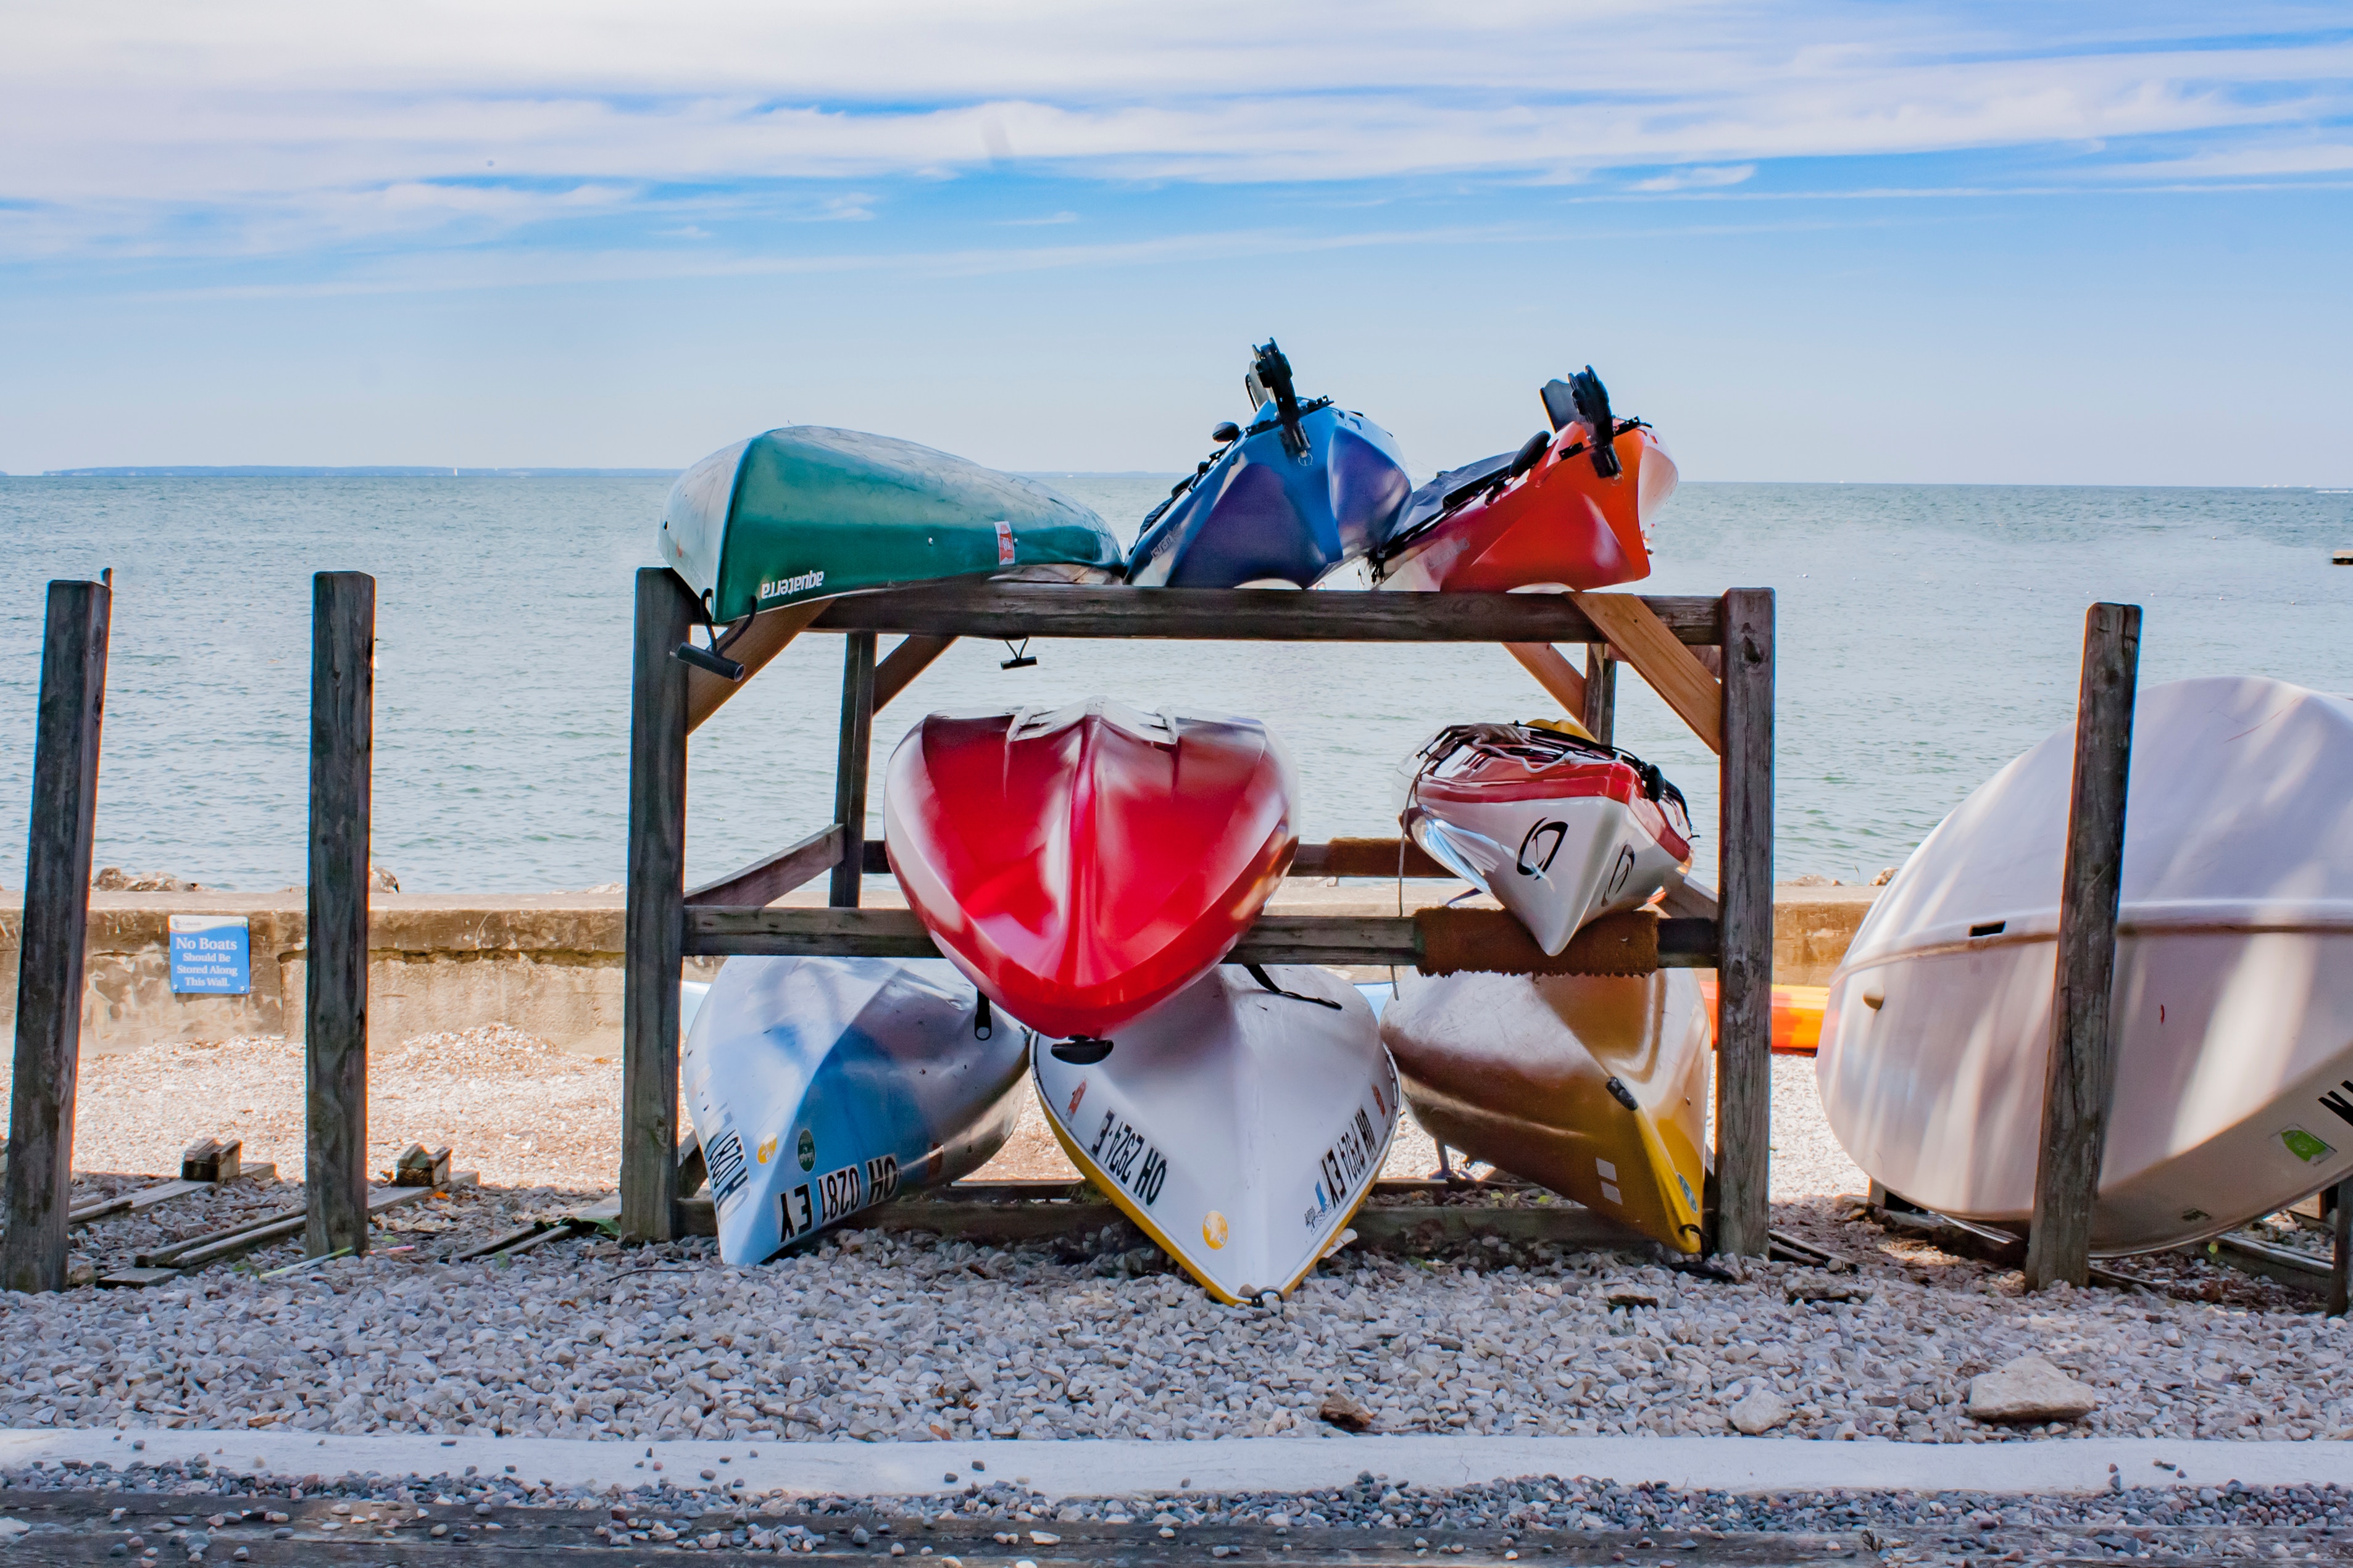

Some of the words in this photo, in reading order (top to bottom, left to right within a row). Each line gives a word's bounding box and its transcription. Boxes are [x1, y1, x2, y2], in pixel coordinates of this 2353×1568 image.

[760, 570, 825, 599] aquaterra
[175, 937, 196, 950] No
[199, 937, 238, 950] Boats
[177, 964, 207, 974] Stored
[209, 965, 238, 977] Along
[183, 952, 216, 962] Should
[218, 953, 231, 963] Be
[185, 977, 206, 986] This
[206, 977, 231, 987] Wall.
[707, 1129, 744, 1190] 0281
[1104, 1121, 1145, 1185] 2924
[1336, 1123, 1366, 1187] 2924
[1355, 1108, 1376, 1159] OH
[818, 1167, 860, 1224] 0281
[867, 1156, 898, 1205] OH
[1133, 1147, 1167, 1206] OH
[1321, 1149, 1347, 1209] EY
[780, 1184, 812, 1243] EY
